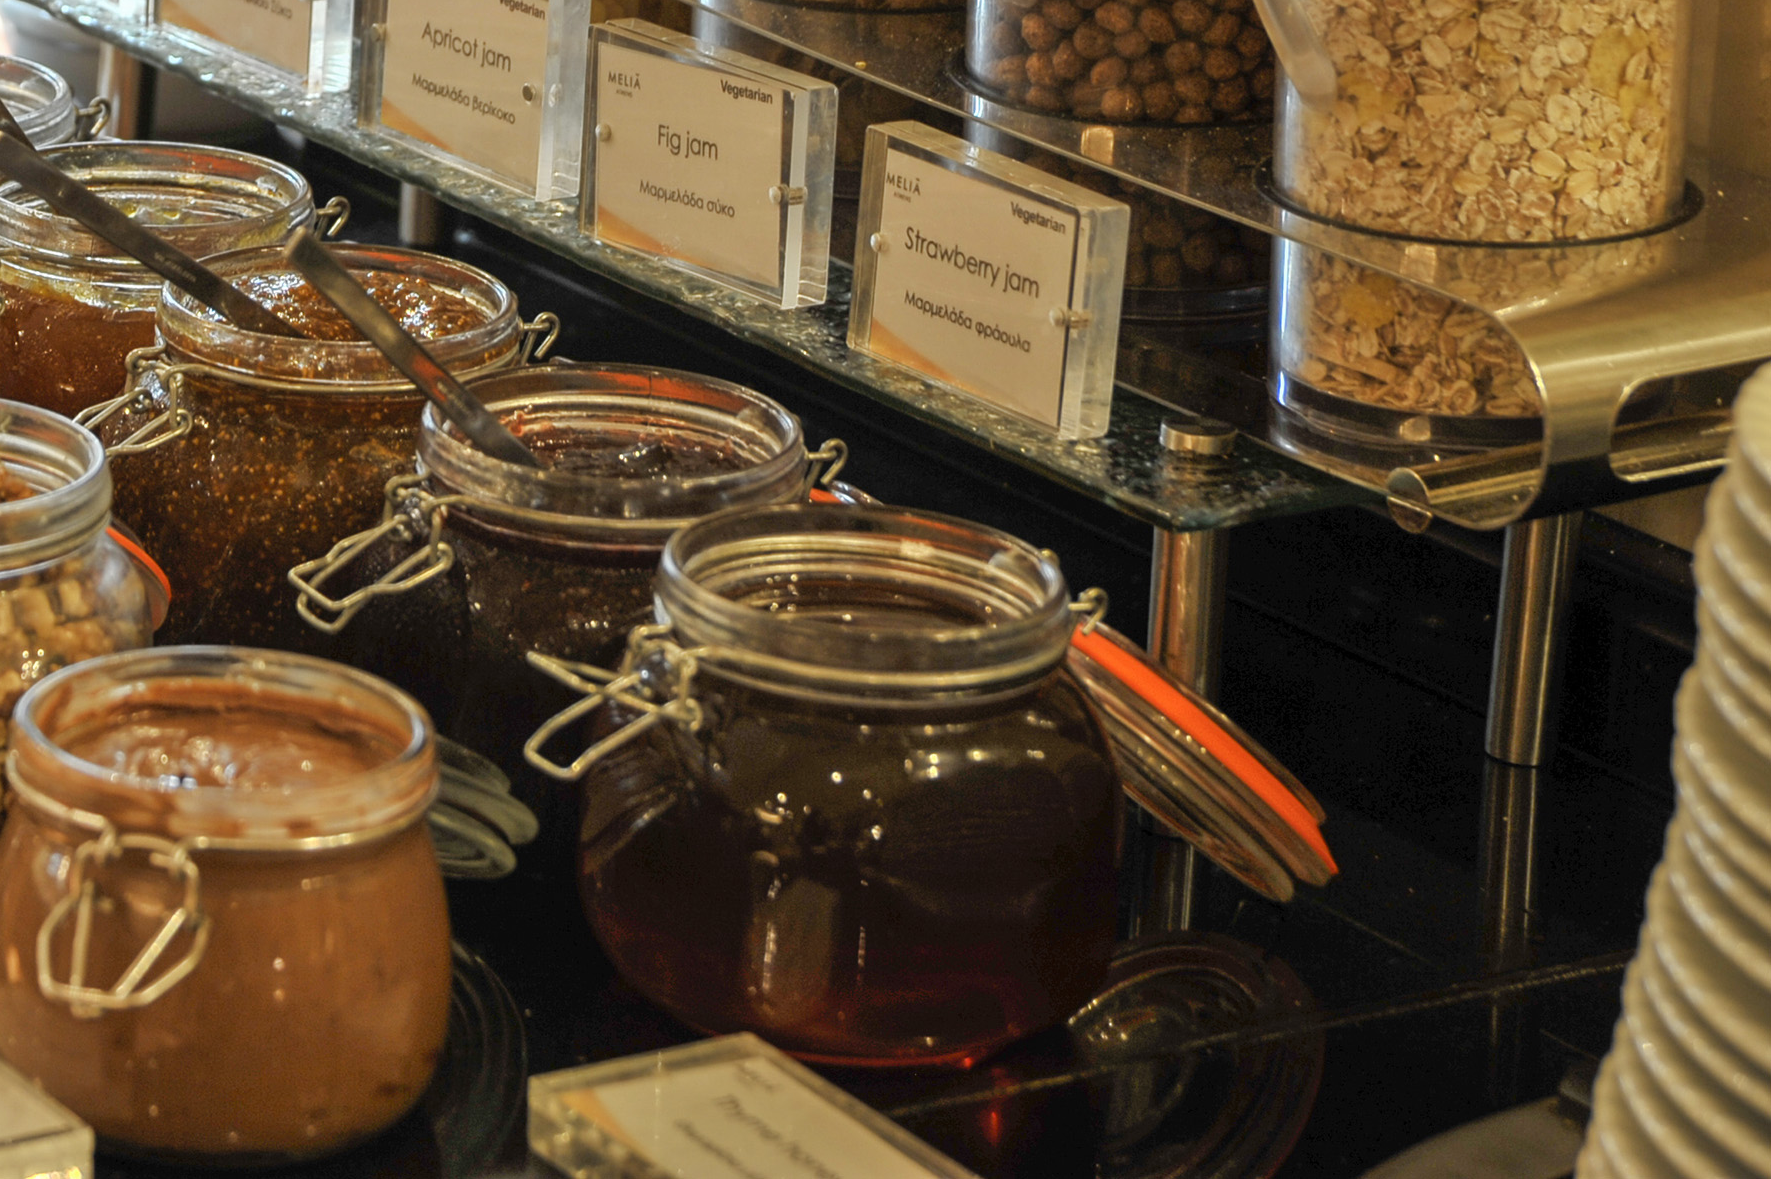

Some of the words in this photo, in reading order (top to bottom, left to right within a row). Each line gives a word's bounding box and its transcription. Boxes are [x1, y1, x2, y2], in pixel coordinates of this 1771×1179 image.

[421, 21, 478, 59] Apricot
[480, 42, 512, 72] jam
[412, 73, 470, 107] Μαρμελάδα
[720, 79, 773, 105] Vegetarian
[658, 124, 681, 156] Fig
[684, 131, 718, 161] jam
[639, 180, 704, 210] Μαρμελάδα
[706, 198, 736, 219] σύκο
[1010, 201, 1066, 234] Vegetarian
[904, 226, 1001, 288] Strawberry
[1002, 264, 1040, 299] jam
[904, 290, 972, 329] Μαρμελάδα
[974, 321, 1032, 353] φράουλα
